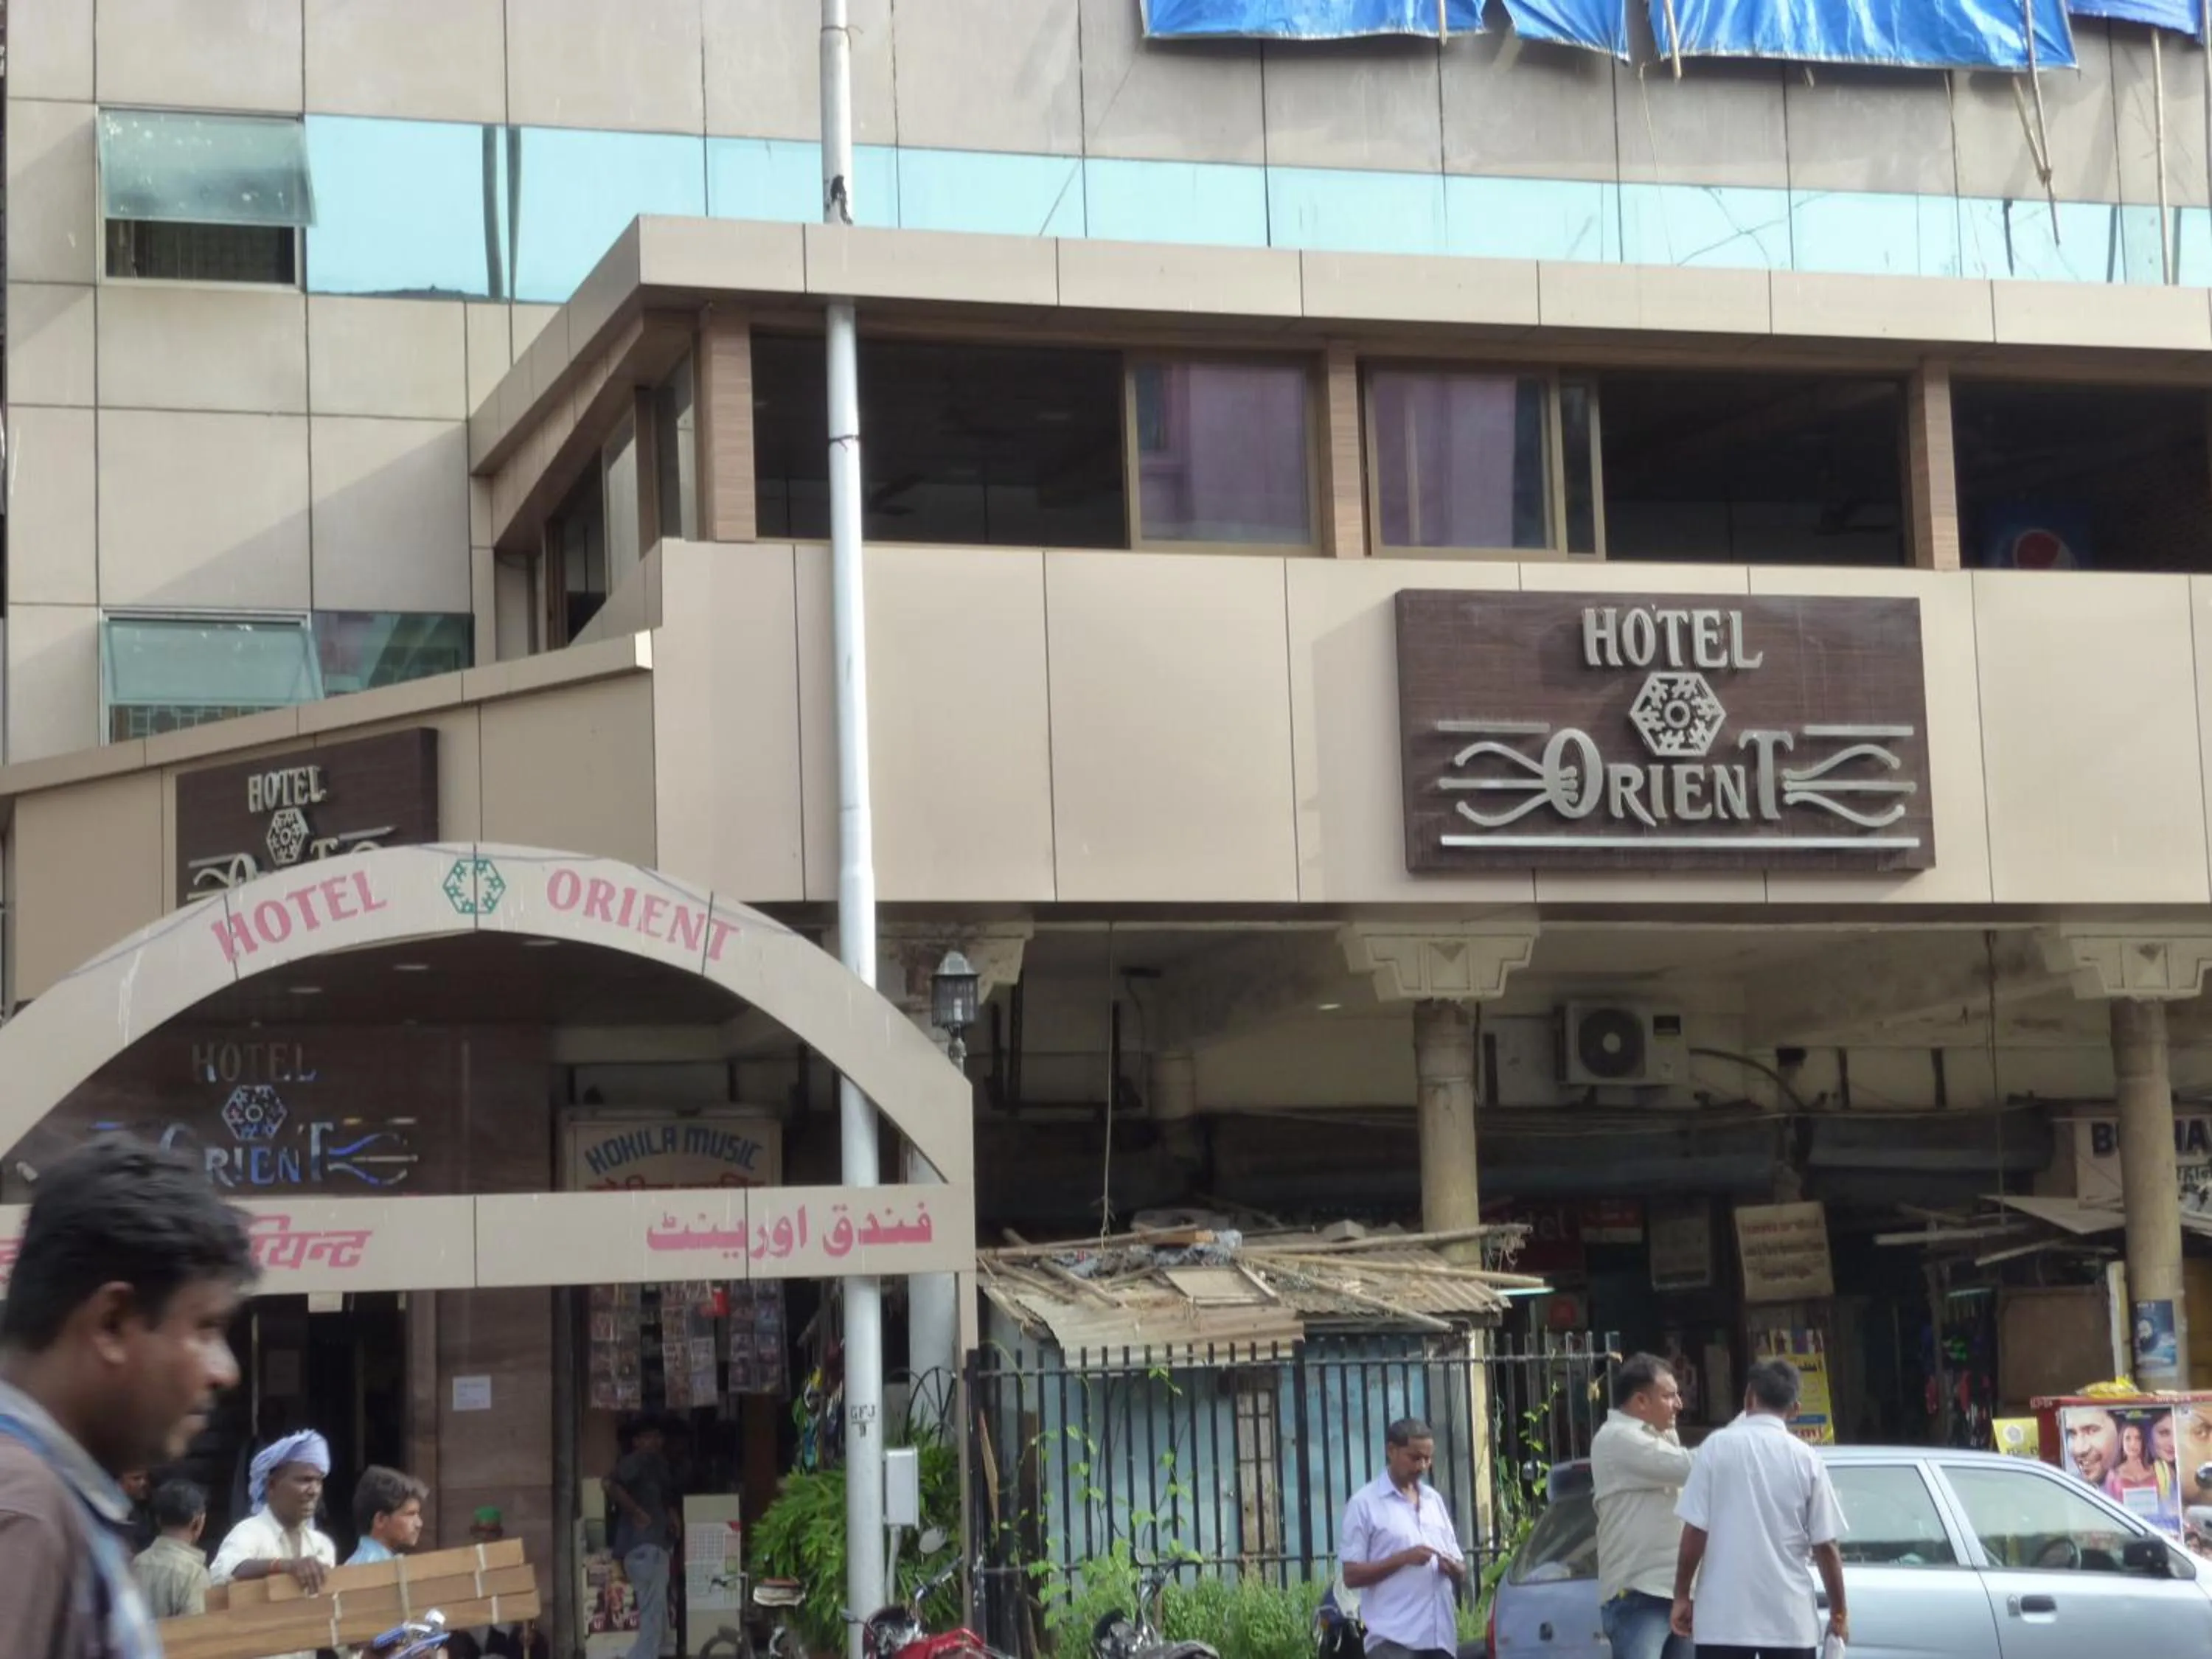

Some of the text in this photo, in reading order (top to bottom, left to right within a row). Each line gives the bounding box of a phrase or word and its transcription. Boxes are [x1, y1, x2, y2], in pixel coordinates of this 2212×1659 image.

[1582, 605, 1763, 669] HOTEL
[248, 765, 327, 813] HOTEL
[1542, 727, 1795, 827] ORIENT
[210, 867, 740, 963] HOTEL ORIENT
[191, 1040, 317, 1083] HOTEL
[684, 1126, 763, 1171] MUSIC
[823, 1201, 933, 1258] فندق
